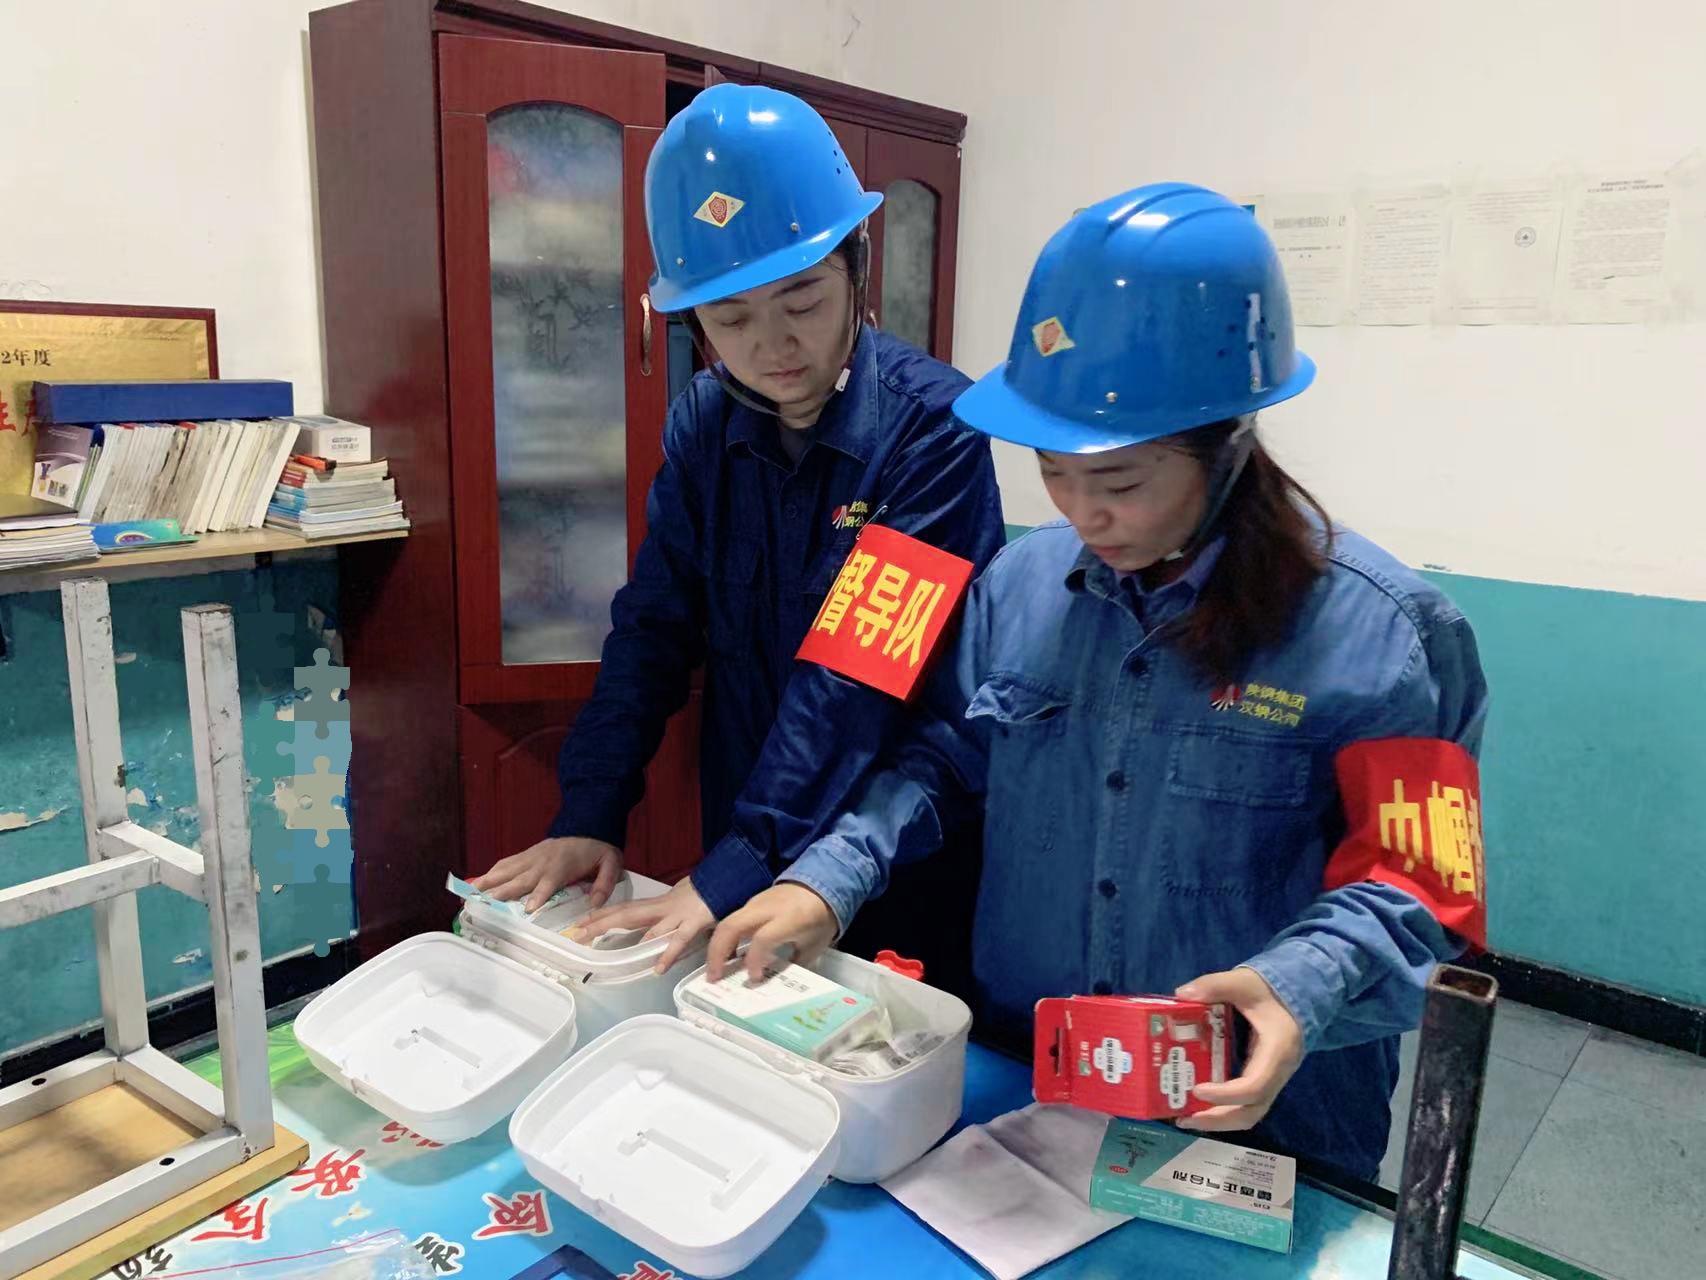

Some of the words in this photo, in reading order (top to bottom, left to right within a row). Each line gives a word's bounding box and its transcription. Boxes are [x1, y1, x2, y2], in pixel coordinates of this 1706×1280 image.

[1, 349, 51, 366] 2年度
[816, 549, 945, 668] 督导队
